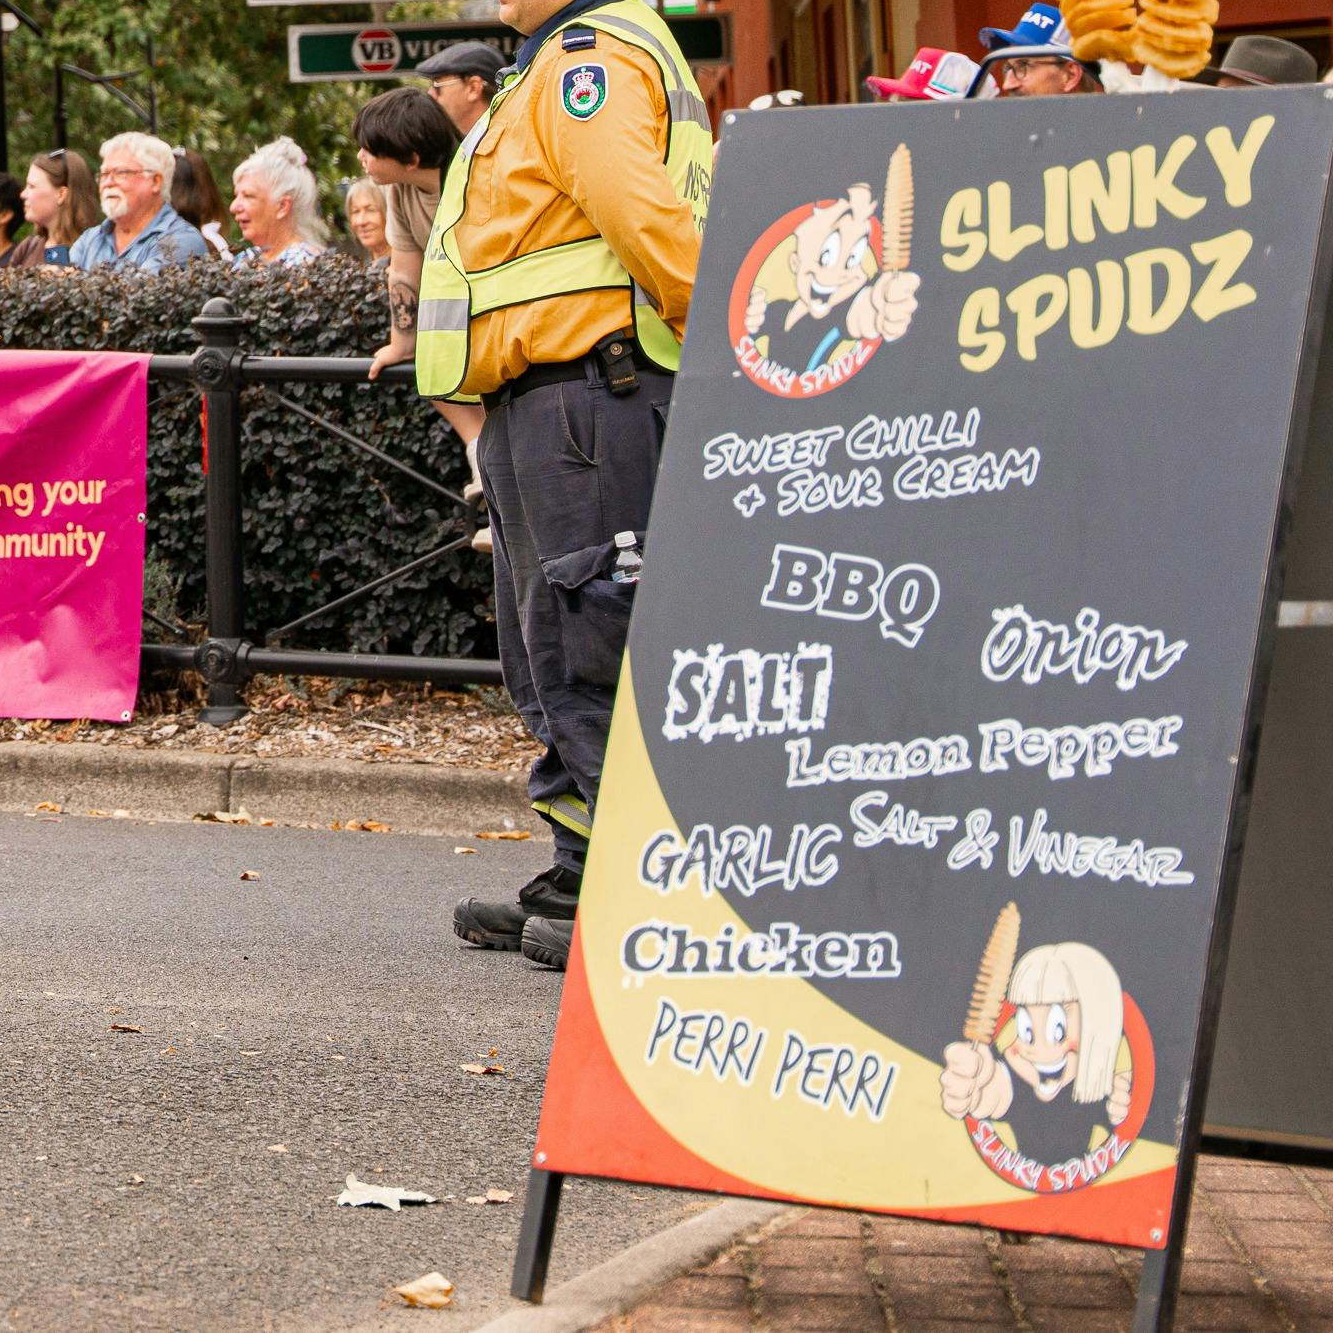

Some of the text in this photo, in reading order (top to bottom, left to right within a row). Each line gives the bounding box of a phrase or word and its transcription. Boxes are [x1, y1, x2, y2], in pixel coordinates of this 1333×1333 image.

[360, 41, 395, 61] VB
[940, 115, 1276, 272] SLINKY
[957, 229, 1257, 373] SPUDZ
[734, 335, 873, 394] SLINKY SPUDZ
[703, 407, 980, 480] SWEET CHILLI
[41, 479, 107, 517] your
[777, 466, 884, 516] SOUR
[893, 446, 1041, 501] CREAM
[760, 543, 940, 648] BBQ
[980, 604, 1189, 691] Onion
[662, 642, 833, 743] SALT
[785, 716, 1184, 788] Lemon Pepper
[639, 822, 842, 896] GARLIC
[947, 808, 1000, 870] &
[621, 919, 903, 980] Chicken
[645, 997, 899, 1121] PERRI PERRI
[971, 1120, 1132, 1192] SLINKY SPUDZ
